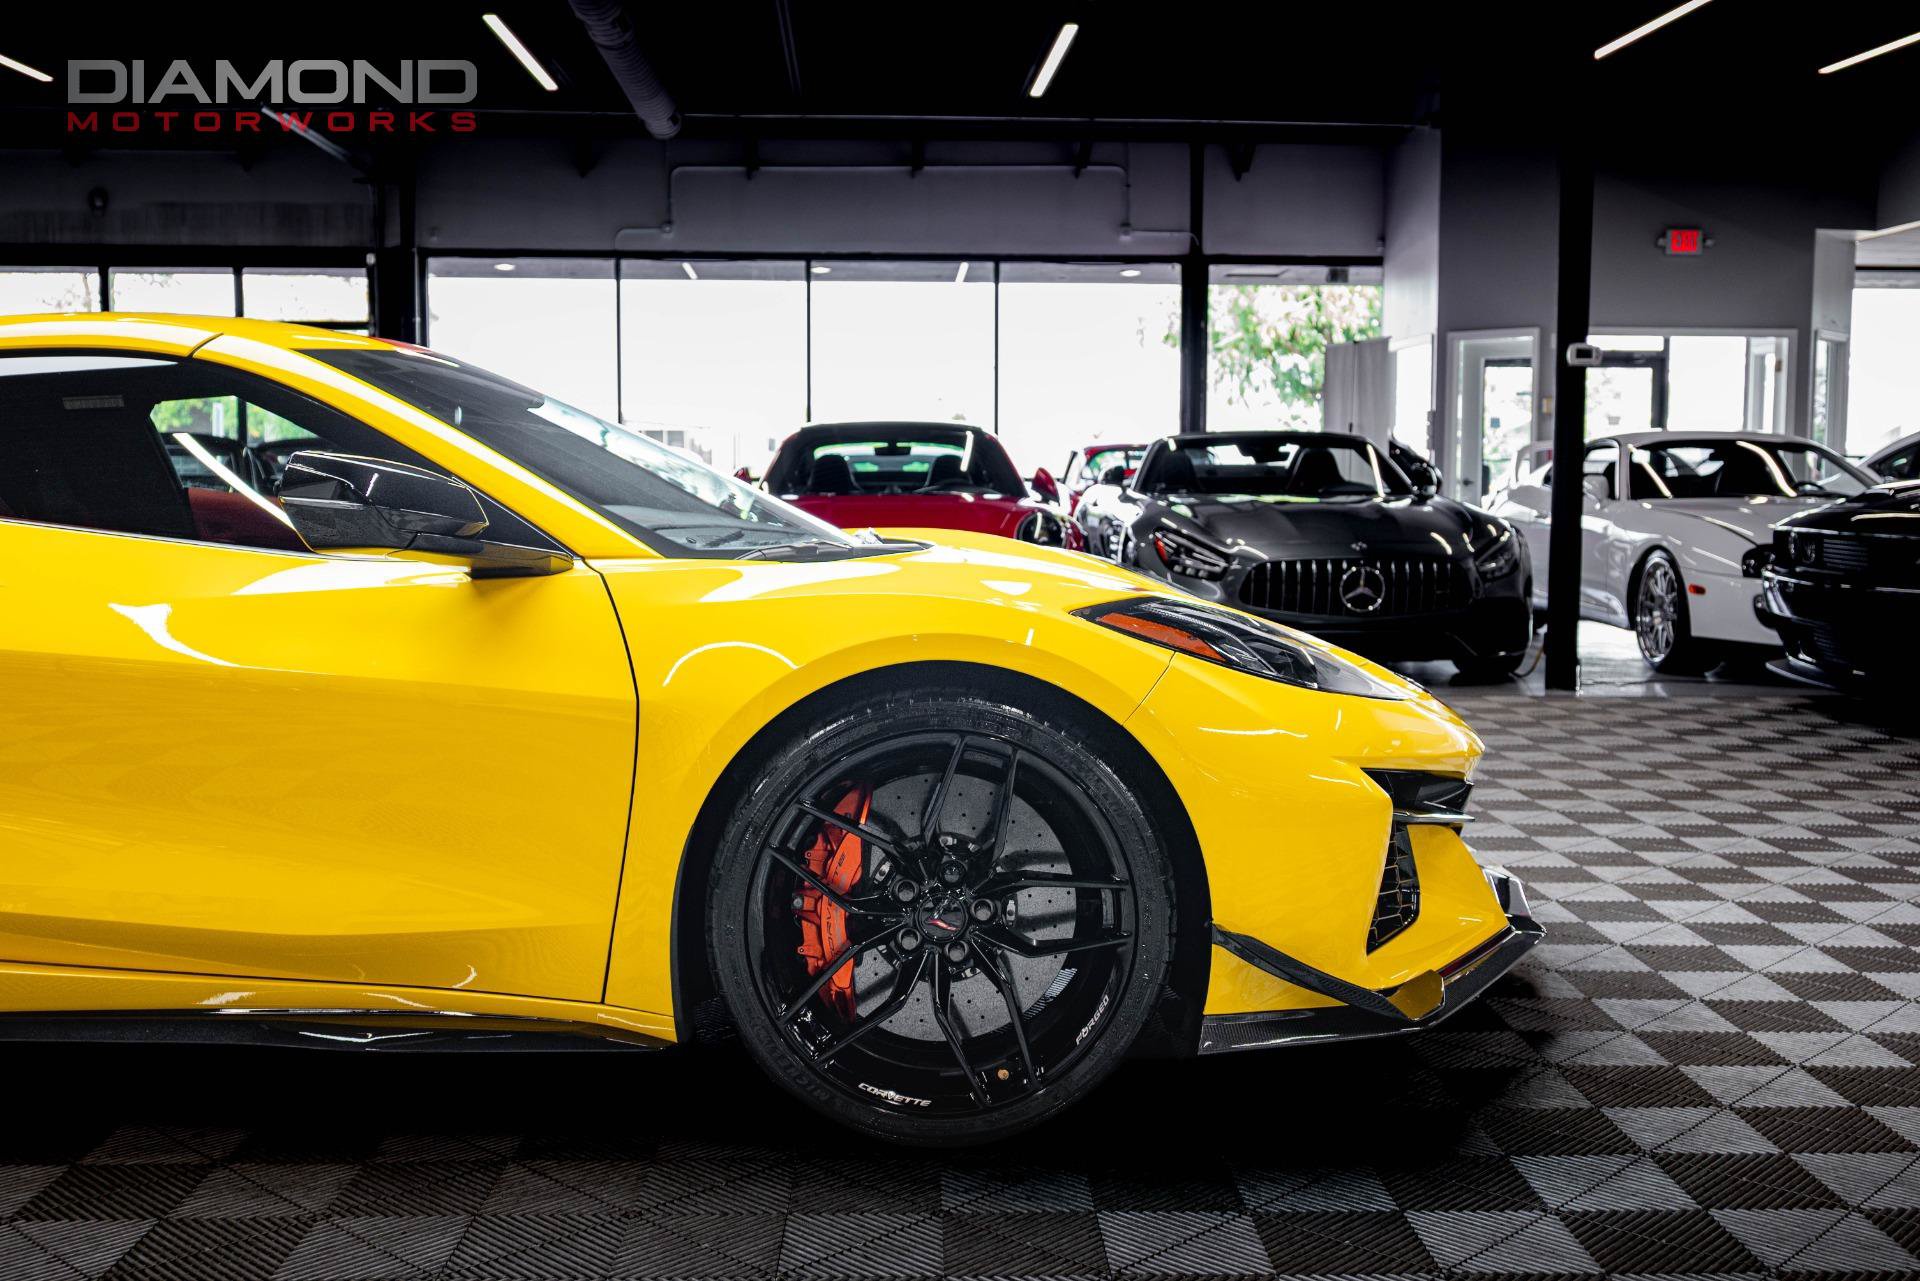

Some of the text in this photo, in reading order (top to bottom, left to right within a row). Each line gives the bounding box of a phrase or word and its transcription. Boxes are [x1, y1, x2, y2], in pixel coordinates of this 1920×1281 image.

[1671, 230, 1698, 252] EXIT
[1076, 995, 1109, 1045] FORGED
[858, 1083, 932, 1106] CORVETTE
